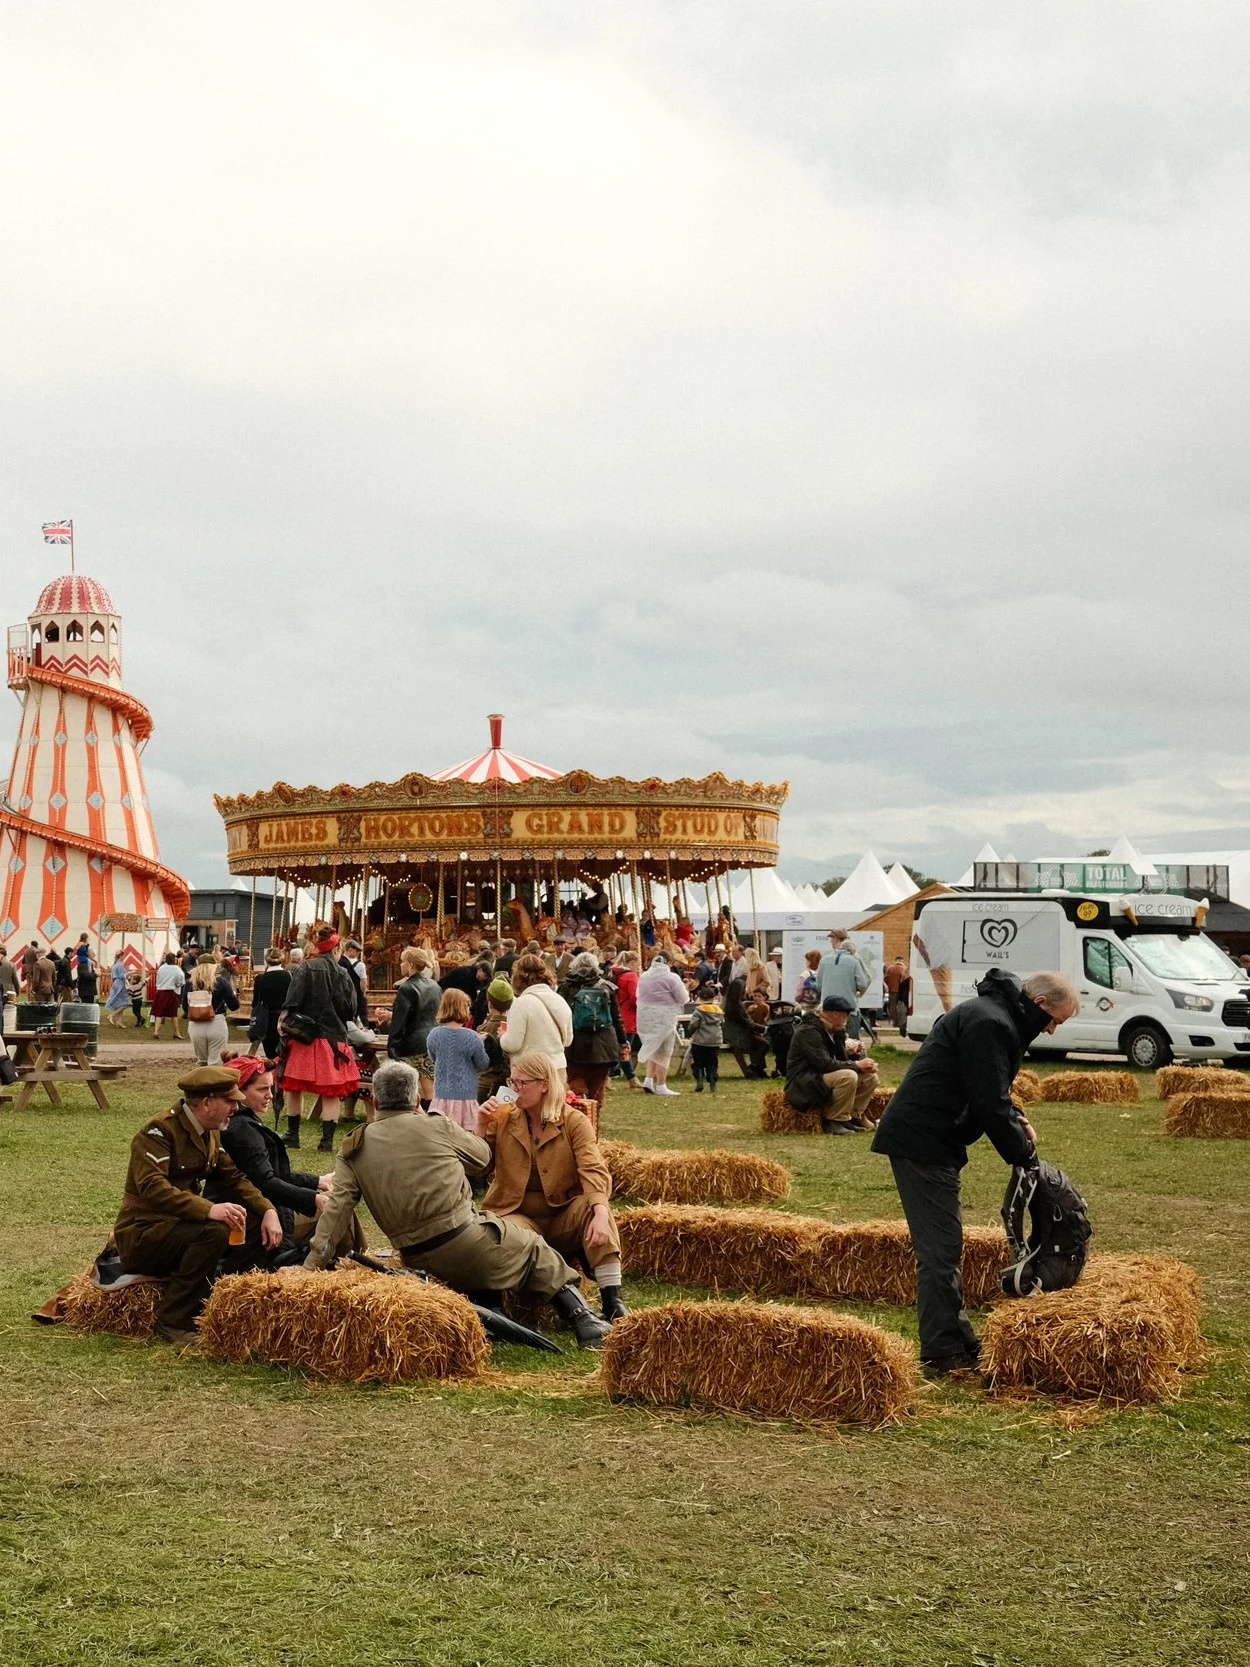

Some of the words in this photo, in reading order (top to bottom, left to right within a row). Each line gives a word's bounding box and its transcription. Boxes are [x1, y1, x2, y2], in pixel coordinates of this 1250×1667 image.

[263, 818, 329, 846] JAMES
[524, 811, 627, 837] GRAND
[662, 811, 719, 838] STUD
[723, 814, 742, 838] OF
[1087, 867, 1127, 880] TOTAL
[988, 903, 1009, 912] cream
[1134, 900, 1154, 915] ice
[1158, 904, 1192, 916] cream
